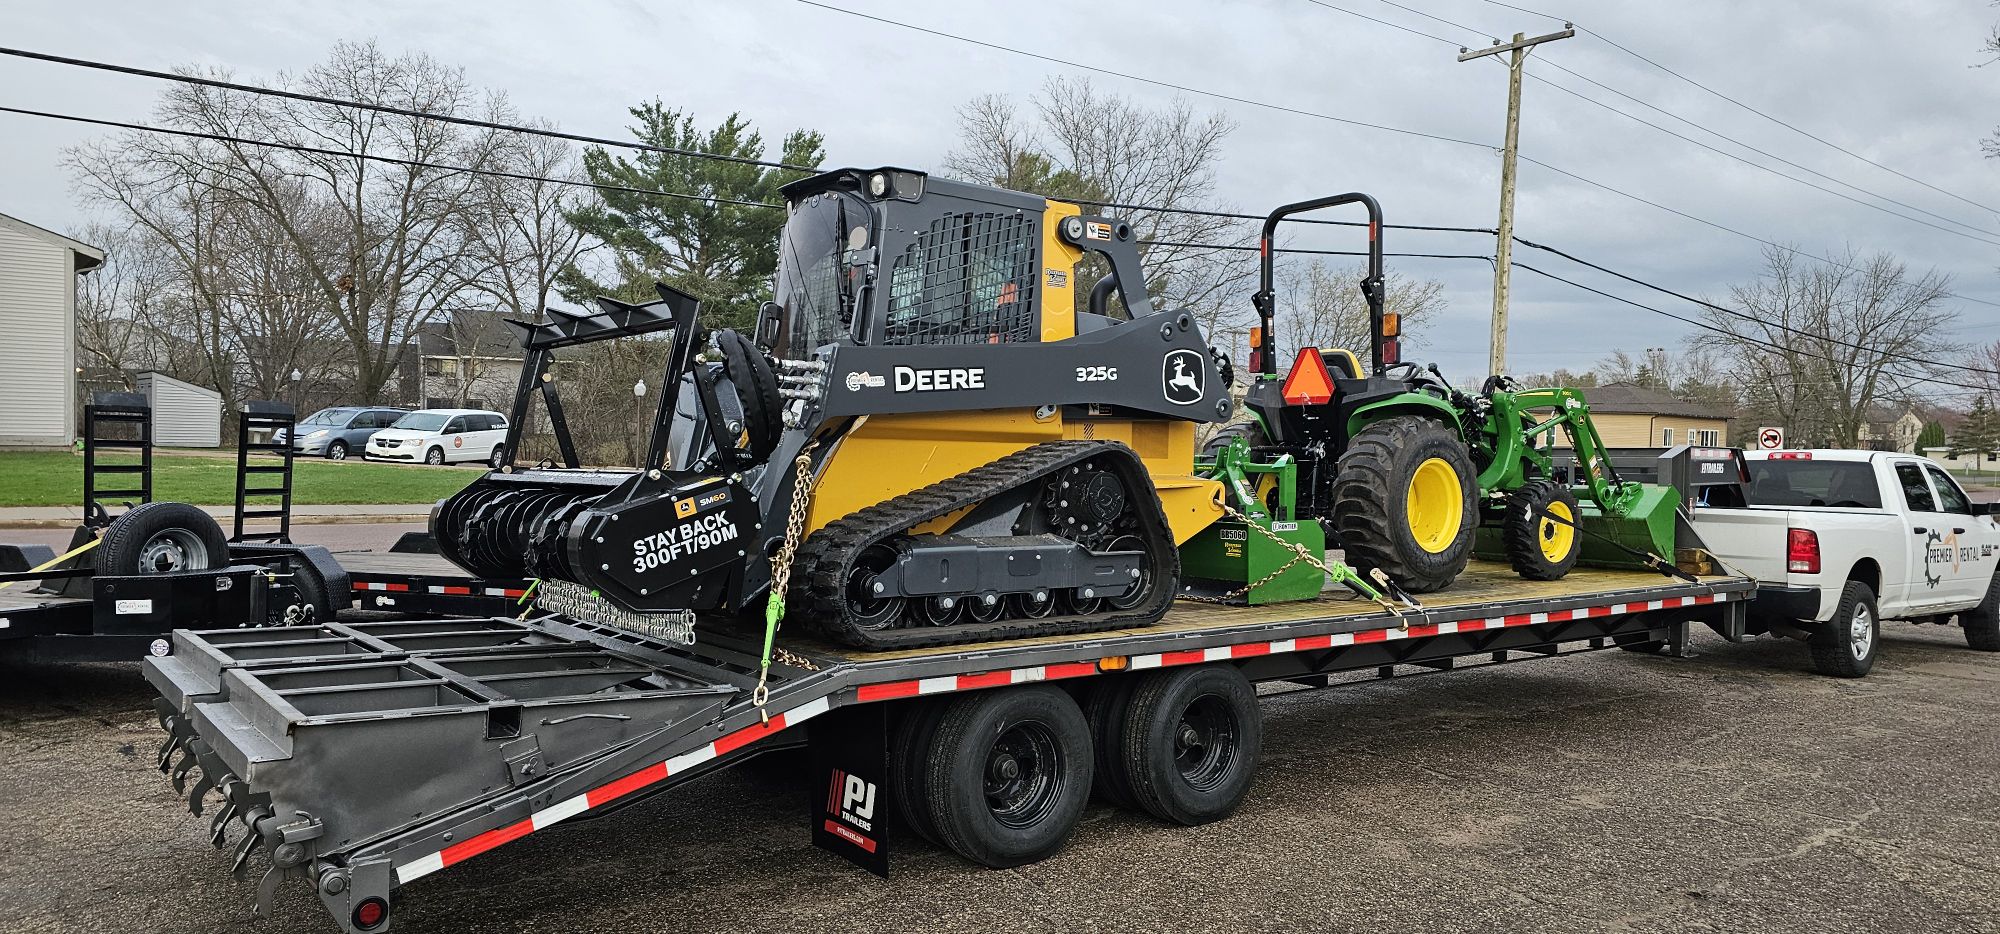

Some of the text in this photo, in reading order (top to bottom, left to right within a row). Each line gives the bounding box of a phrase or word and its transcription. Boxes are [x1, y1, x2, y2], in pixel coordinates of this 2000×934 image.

[894, 366, 985, 392] DEERE
[1076, 366, 1117, 382] 325G
[700, 492, 726, 507] SM60
[633, 511, 729, 556] STAY BACK
[1220, 530, 1247, 540] BB5060
[633, 524, 738, 573] 300FT/90M
[1929, 548, 1952, 563] PREMIER
[1959, 547, 1979, 562] RENTAL
[843, 774, 876, 819] PJ
[842, 811, 872, 832] TRAILERS
